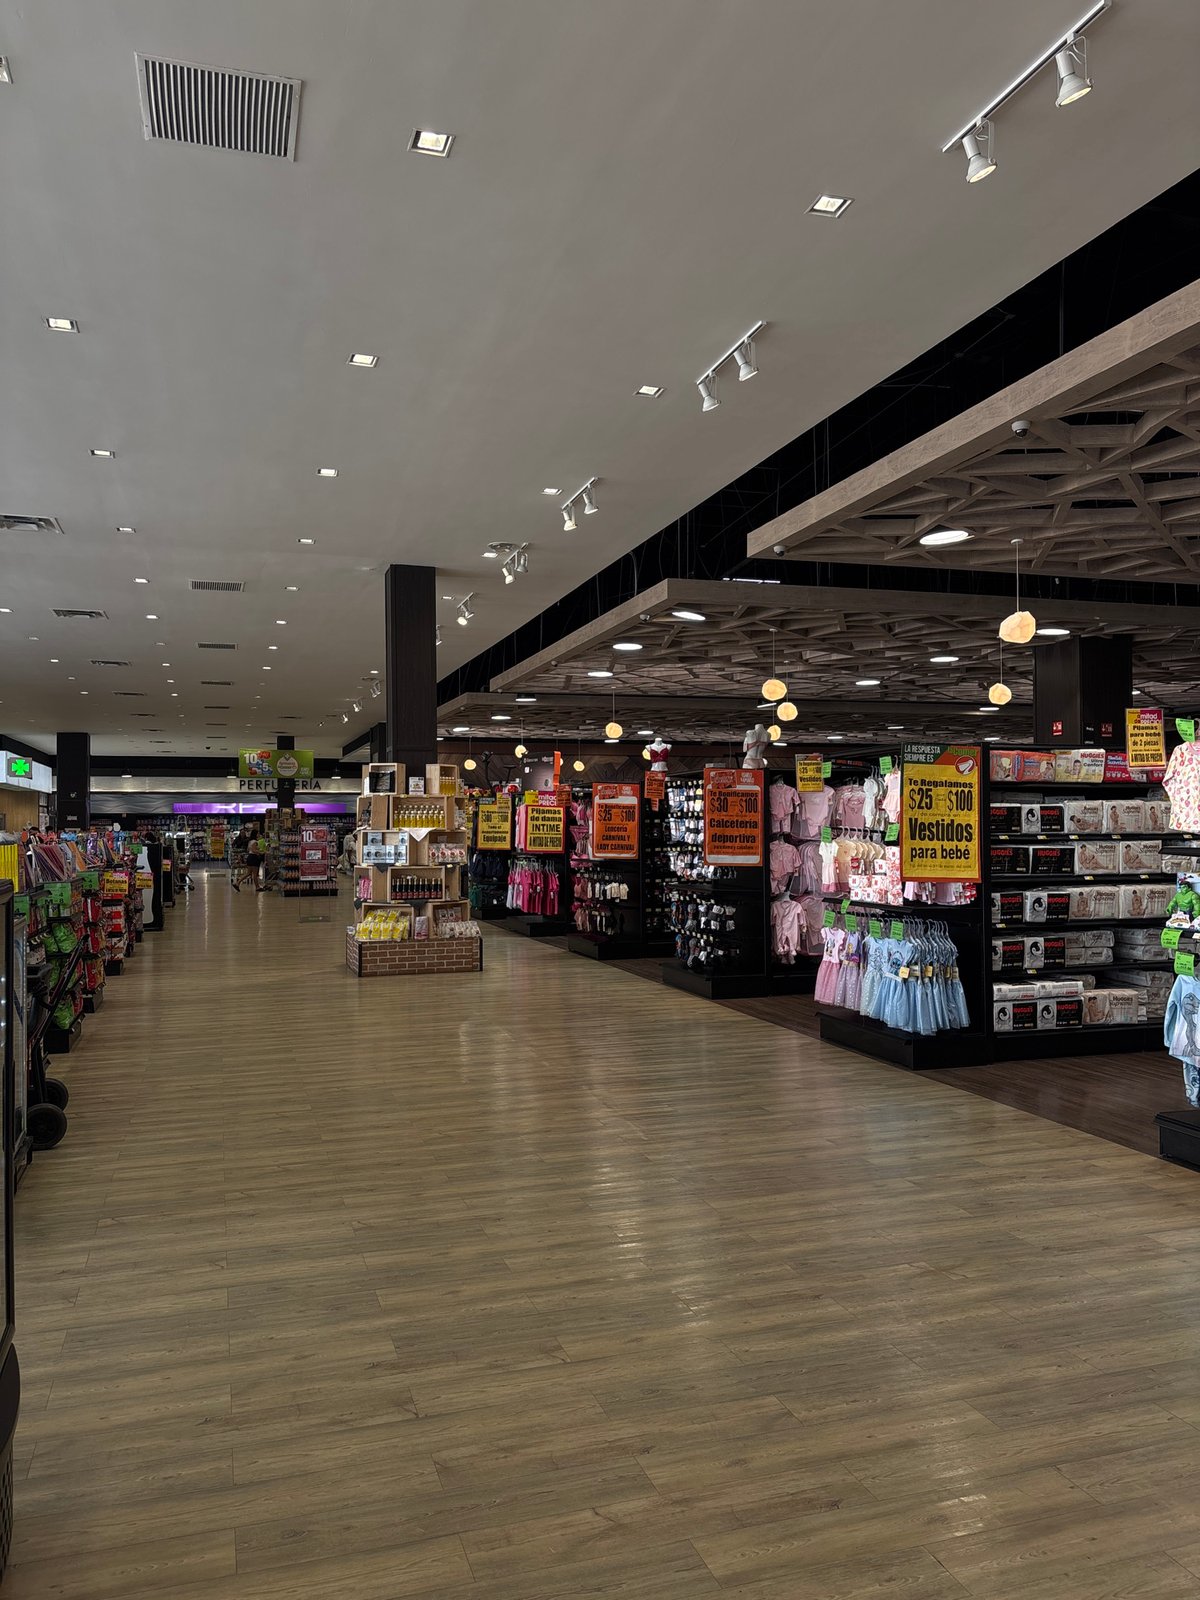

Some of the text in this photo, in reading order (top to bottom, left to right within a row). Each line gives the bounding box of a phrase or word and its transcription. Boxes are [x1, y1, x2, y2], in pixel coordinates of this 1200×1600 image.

[904, 744, 940, 754] LA RESPUESTA
[244, 753, 258, 764] 10
[904, 754, 934, 762] SIEMPRE ES
[240, 778, 322, 790] PERFUERÍA
[908, 778, 974, 789] Te Regalamos
[710, 797, 728, 813] $30
[738, 798, 758, 814] $100
[908, 788, 973, 812] $25 $100
[598, 809, 636, 822] $25 $100
[532, 824, 561, 832] INTIME
[908, 817, 973, 843] Vestidos
[302, 830, 313, 842] 10
[712, 833, 756, 844] deportiva
[910, 845, 970, 862] para bebé
[1037, 848, 1061, 857] HUGGIES
